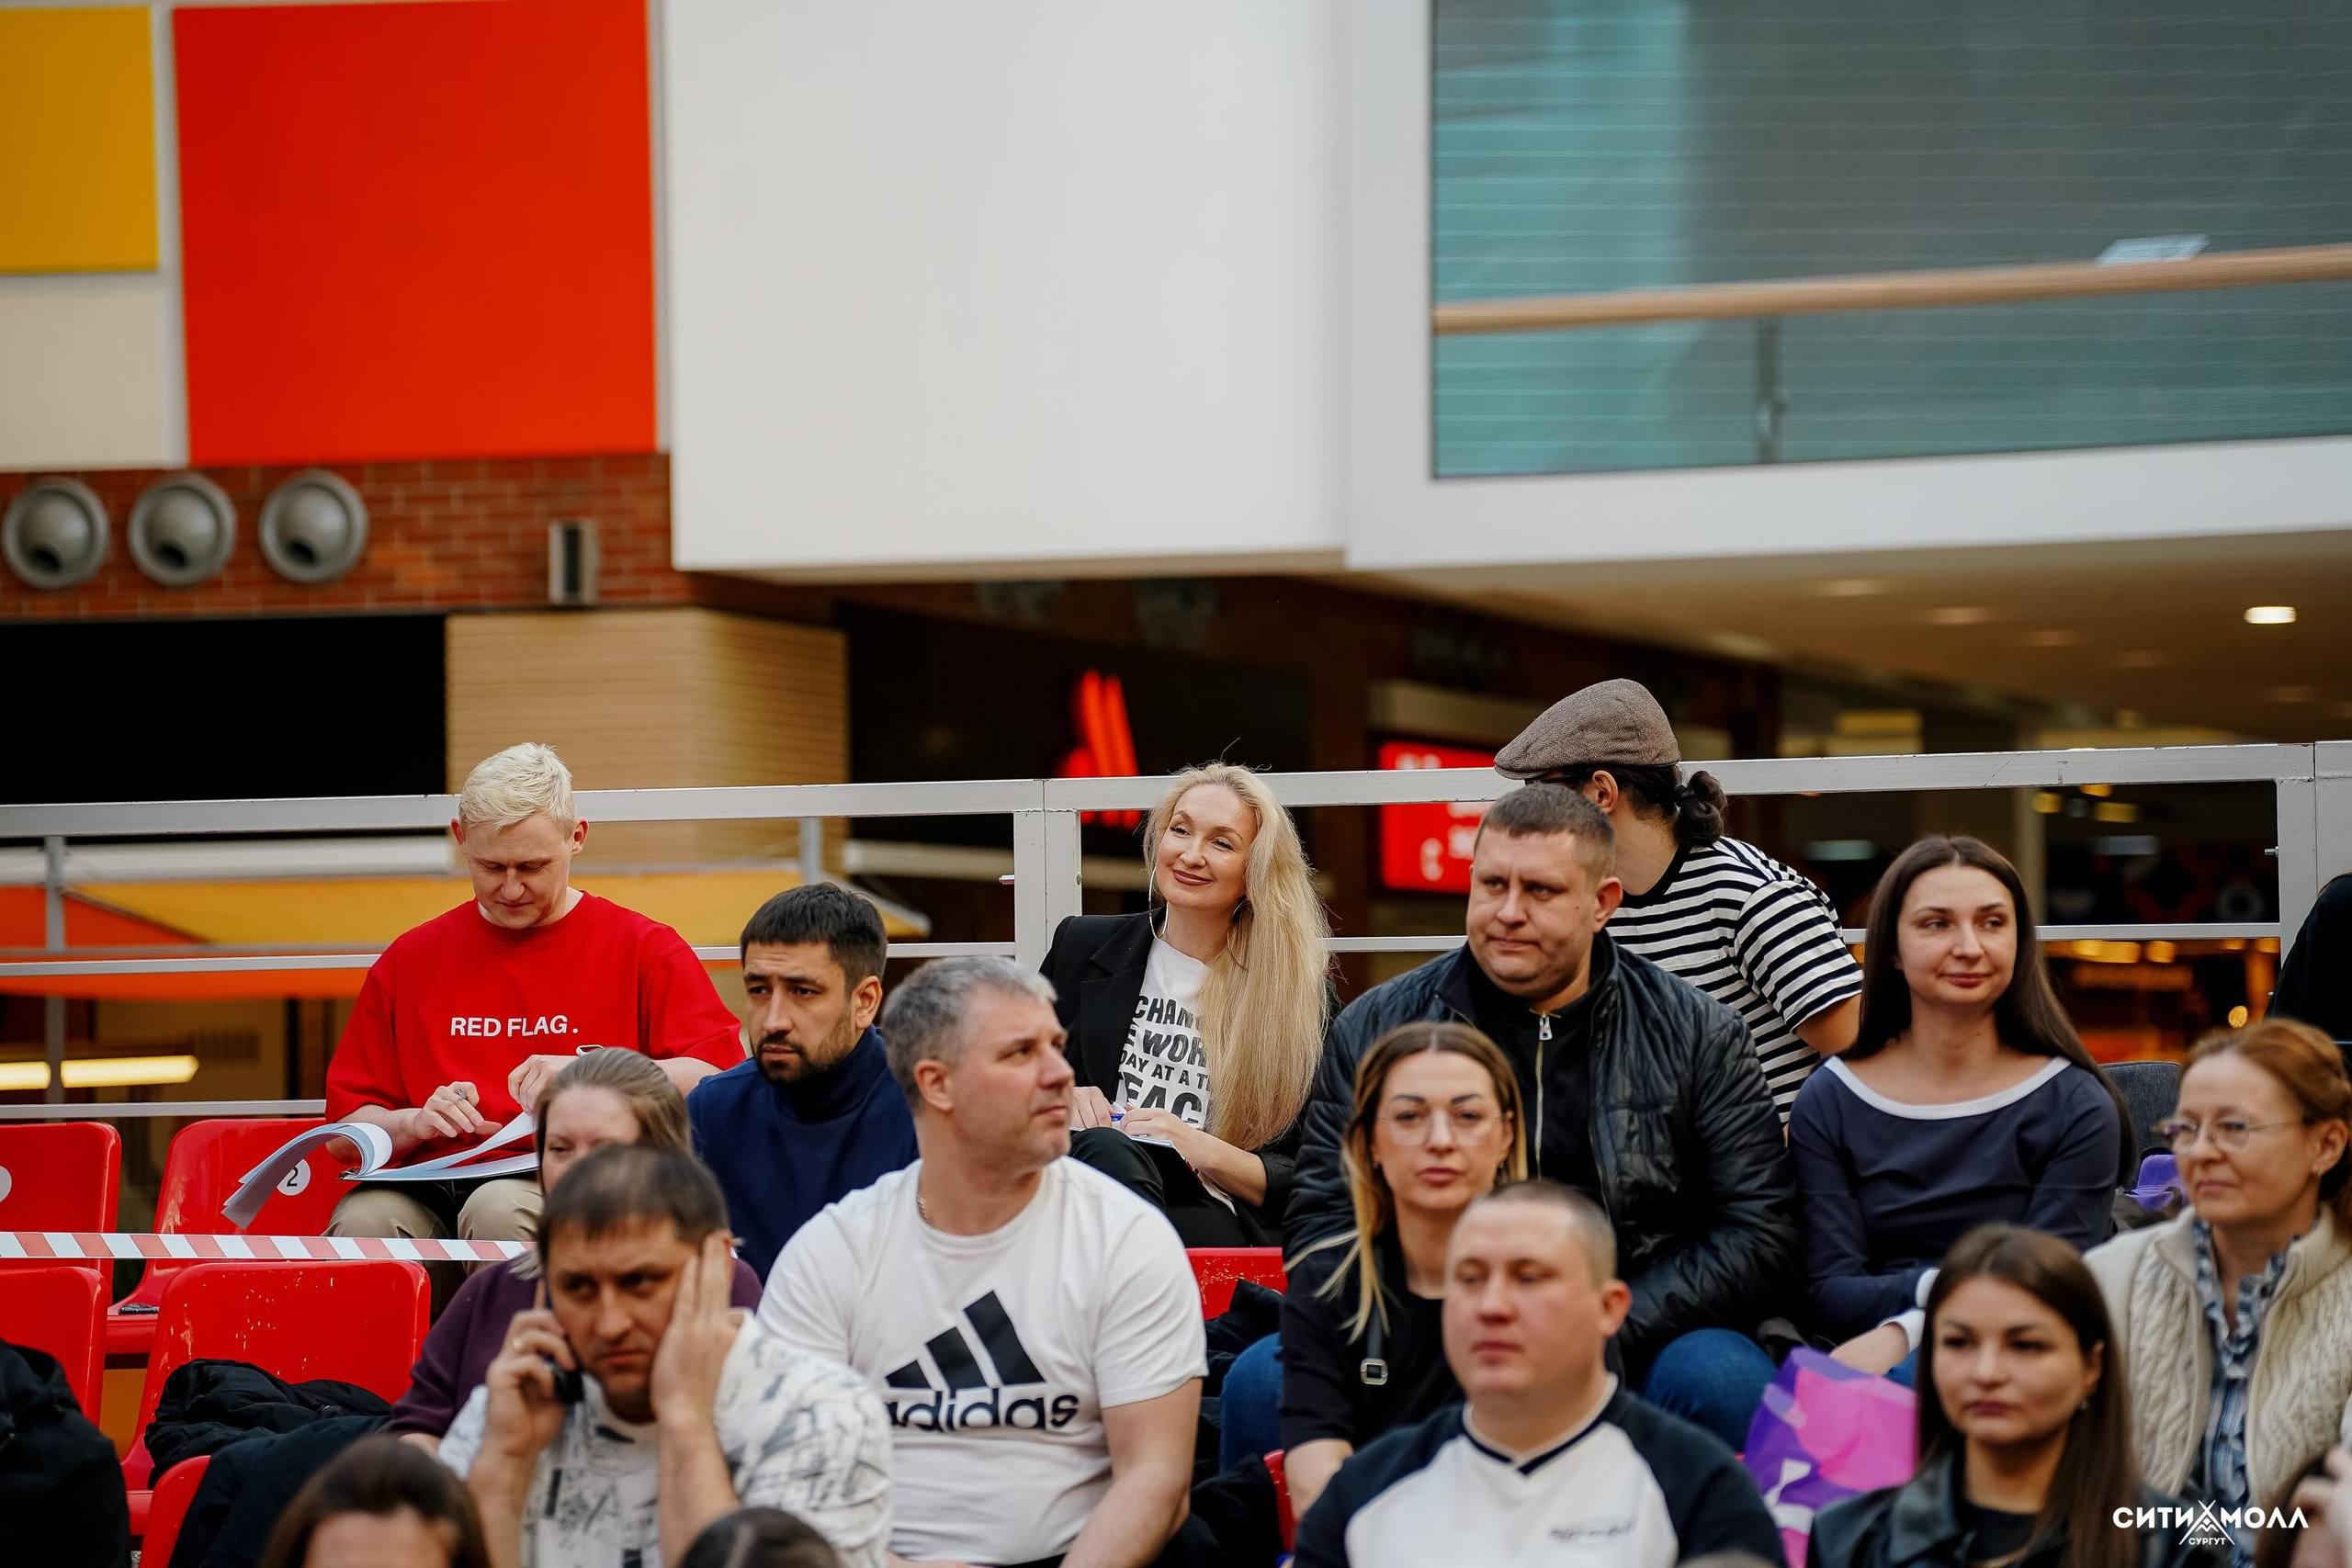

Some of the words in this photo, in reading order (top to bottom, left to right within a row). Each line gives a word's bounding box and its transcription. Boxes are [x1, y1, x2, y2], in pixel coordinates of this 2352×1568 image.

[451, 1017, 502, 1037] RED
[507, 1015, 579, 1037] FLAG.
[1150, 1064, 1175, 1082] AT
[1178, 1069, 1191, 1087] A
[287, 1167, 299, 1187] 2
